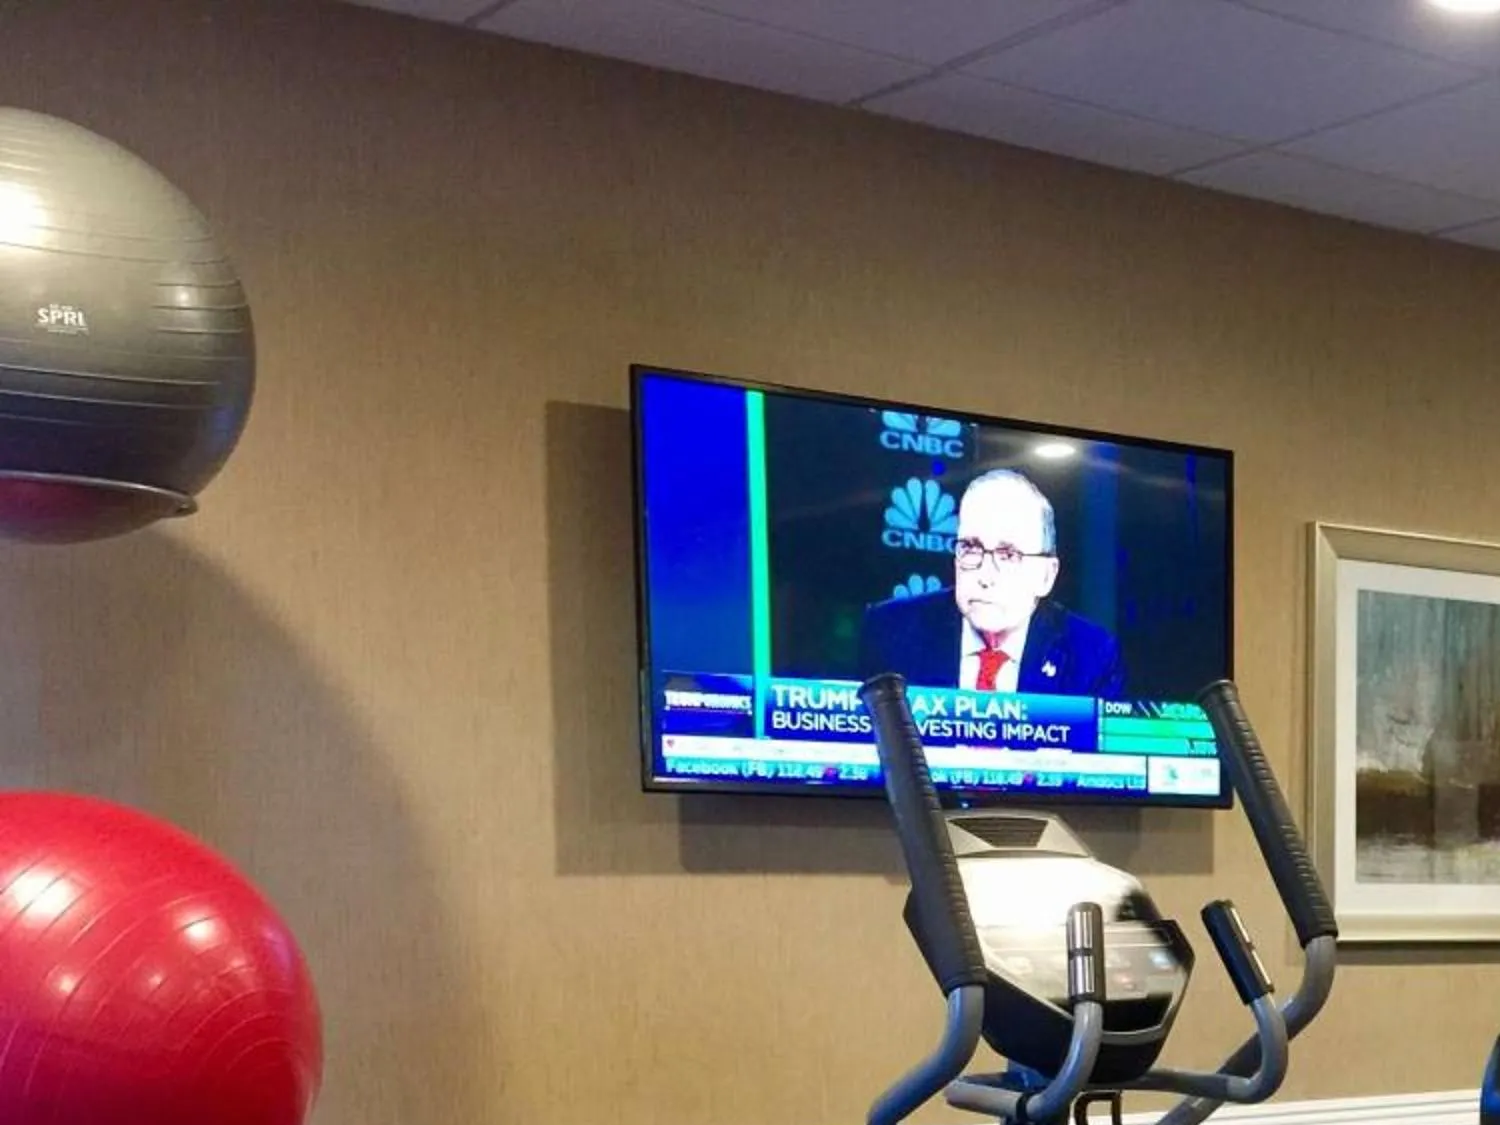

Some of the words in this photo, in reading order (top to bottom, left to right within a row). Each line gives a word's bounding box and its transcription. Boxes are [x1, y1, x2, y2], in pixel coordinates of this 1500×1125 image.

[37, 307, 85, 327] SPRI
[880, 430, 965, 459] CNBC
[771, 684, 864, 712] TRUMP
[911, 694, 949, 718] AX
[954, 697, 1029, 721] PLAN:
[1104, 701, 1133, 715] DOW
[771, 711, 873, 733] BUSINESS
[914, 718, 998, 740] VESTING
[1002, 723, 1072, 744] IMPACT
